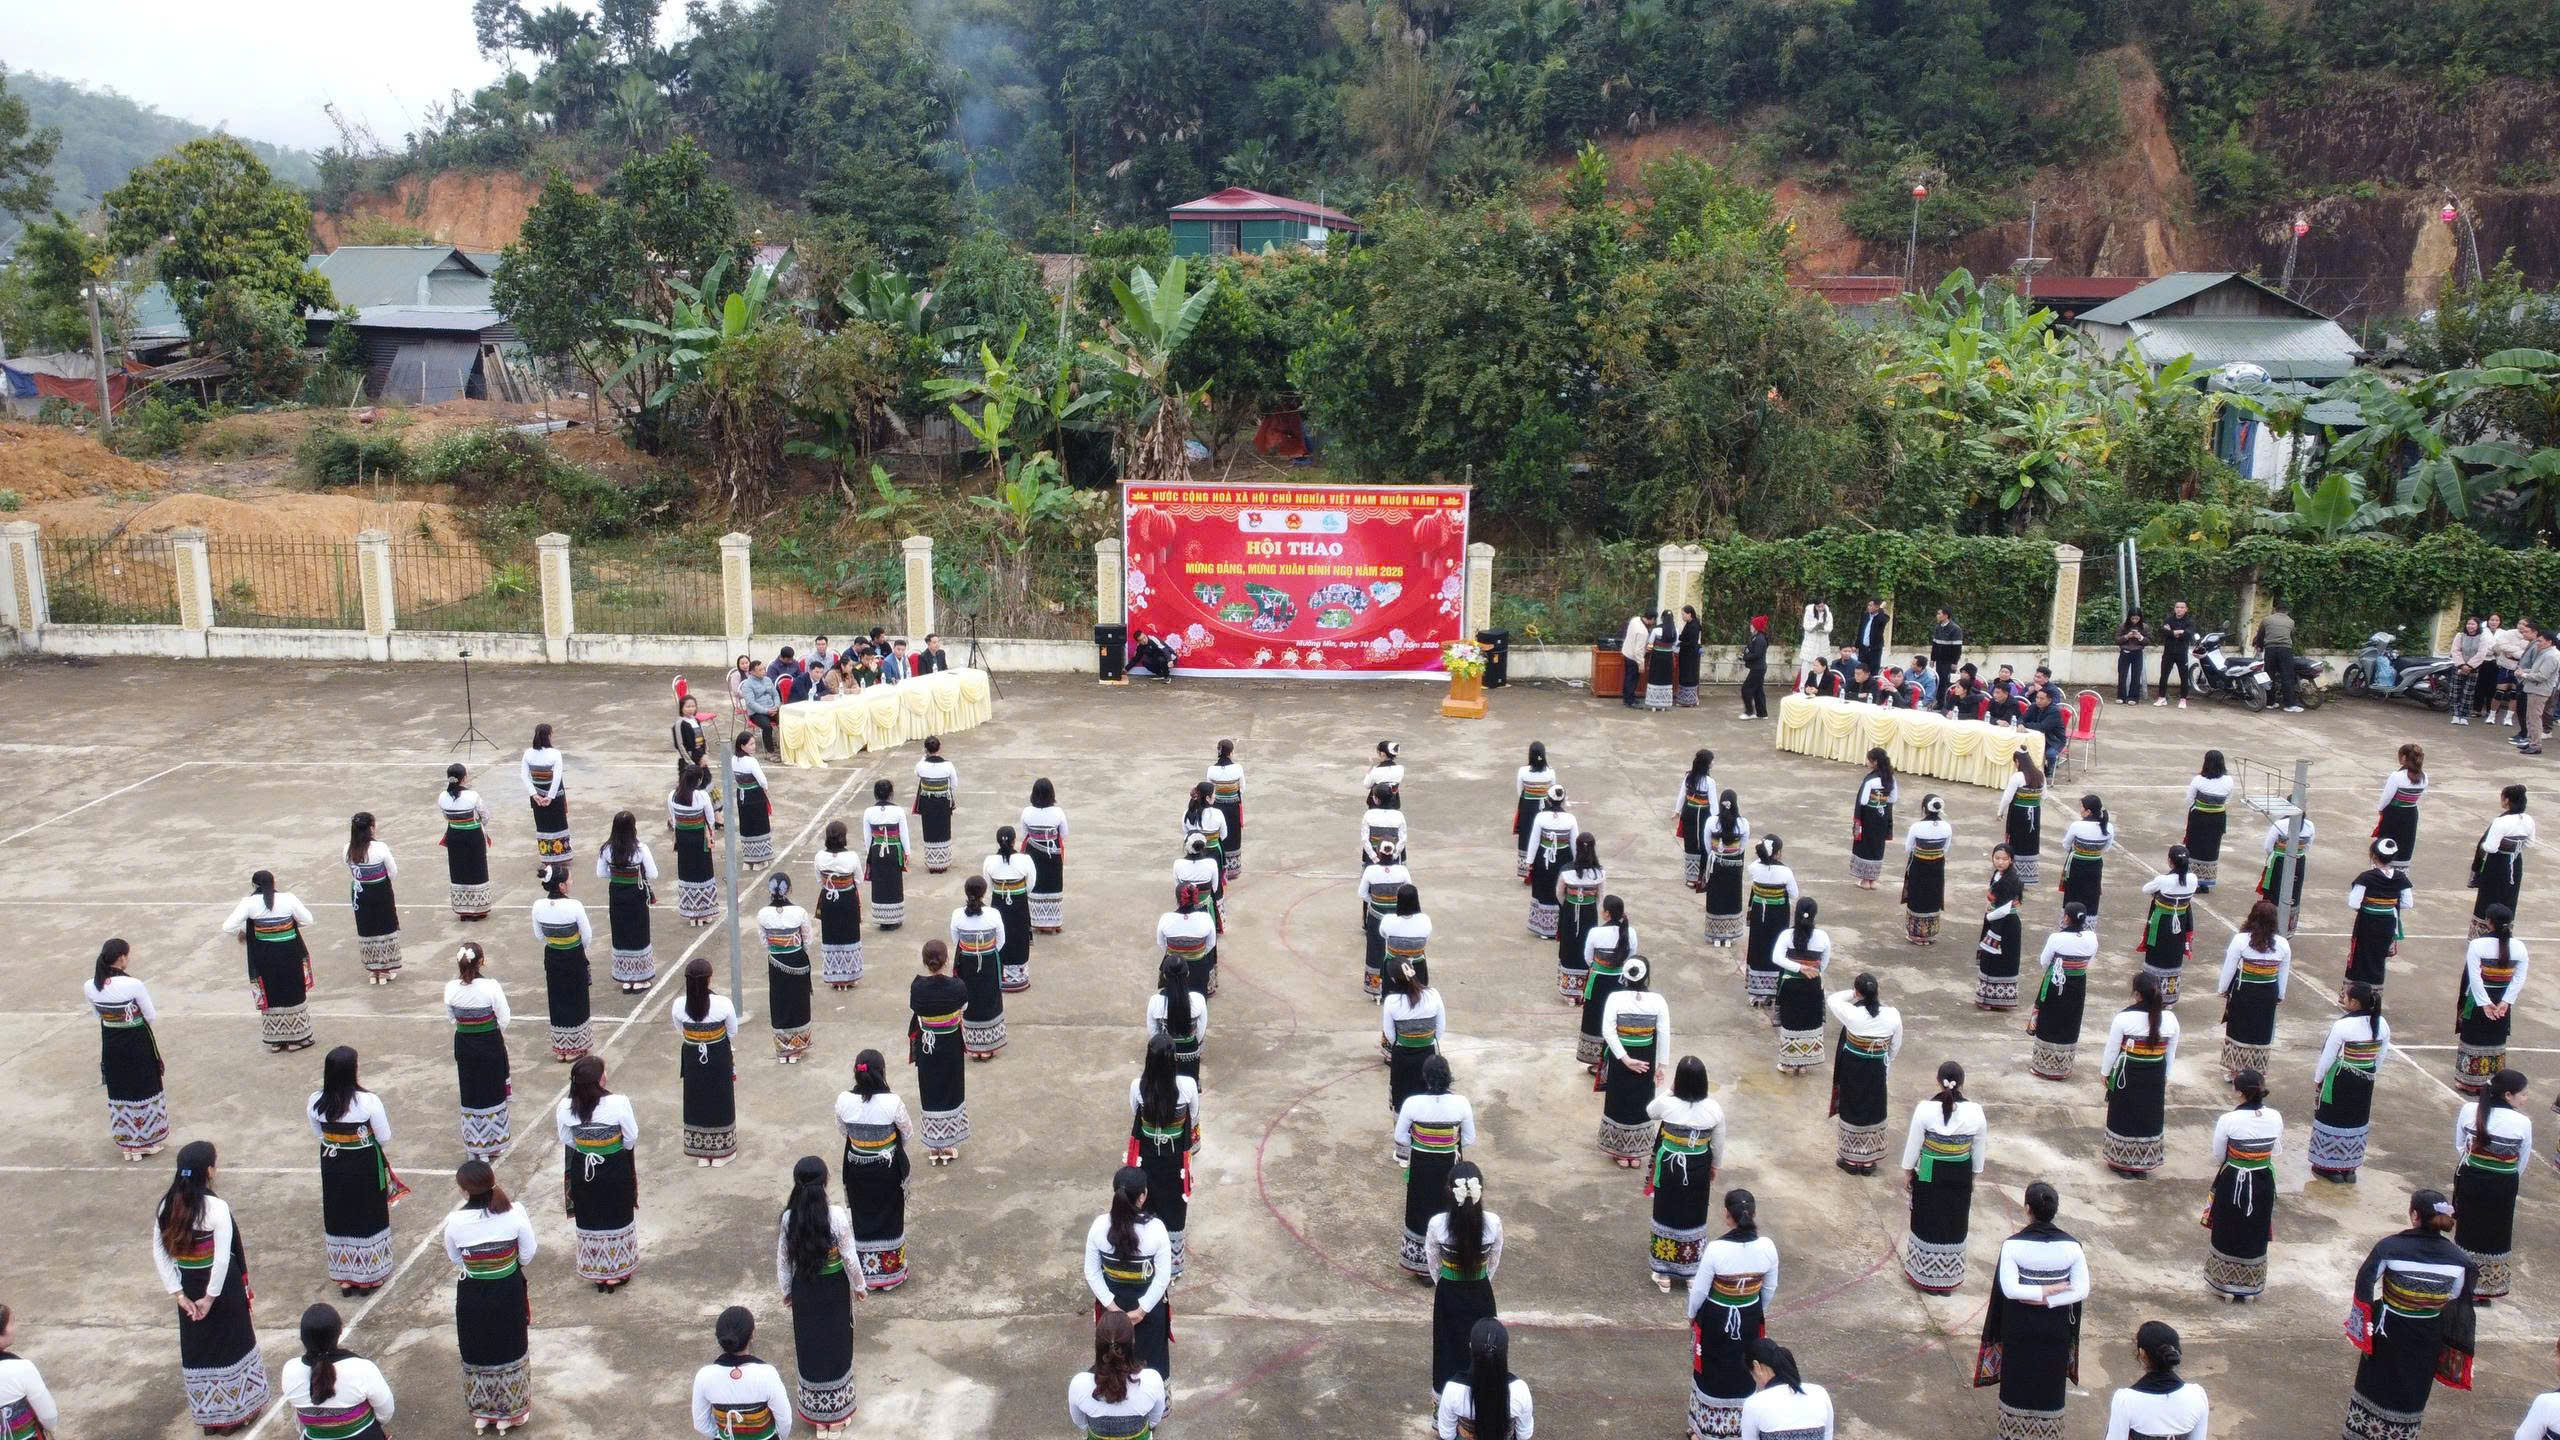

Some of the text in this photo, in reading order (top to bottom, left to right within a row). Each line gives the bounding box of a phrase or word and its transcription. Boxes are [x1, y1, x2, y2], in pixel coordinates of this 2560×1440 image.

[1182, 491, 1208, 504] CỘNG
[1252, 491, 1269, 504] HỘI
[1272, 491, 1292, 504] CHỦ
[1329, 492, 1351, 506] VIỆT
[1353, 494, 1377, 505] NAM
[1380, 493, 1409, 505] MUÔN
[1247, 538, 1343, 559] HỘI THAO
[1216, 560, 1246, 576] ĐẢNG,
[1279, 563, 1305, 576] XUÂN
[1333, 565, 1353, 578] NGỌ
[1355, 564, 1378, 576] NĂM
[1380, 566, 1404, 577] 2026
